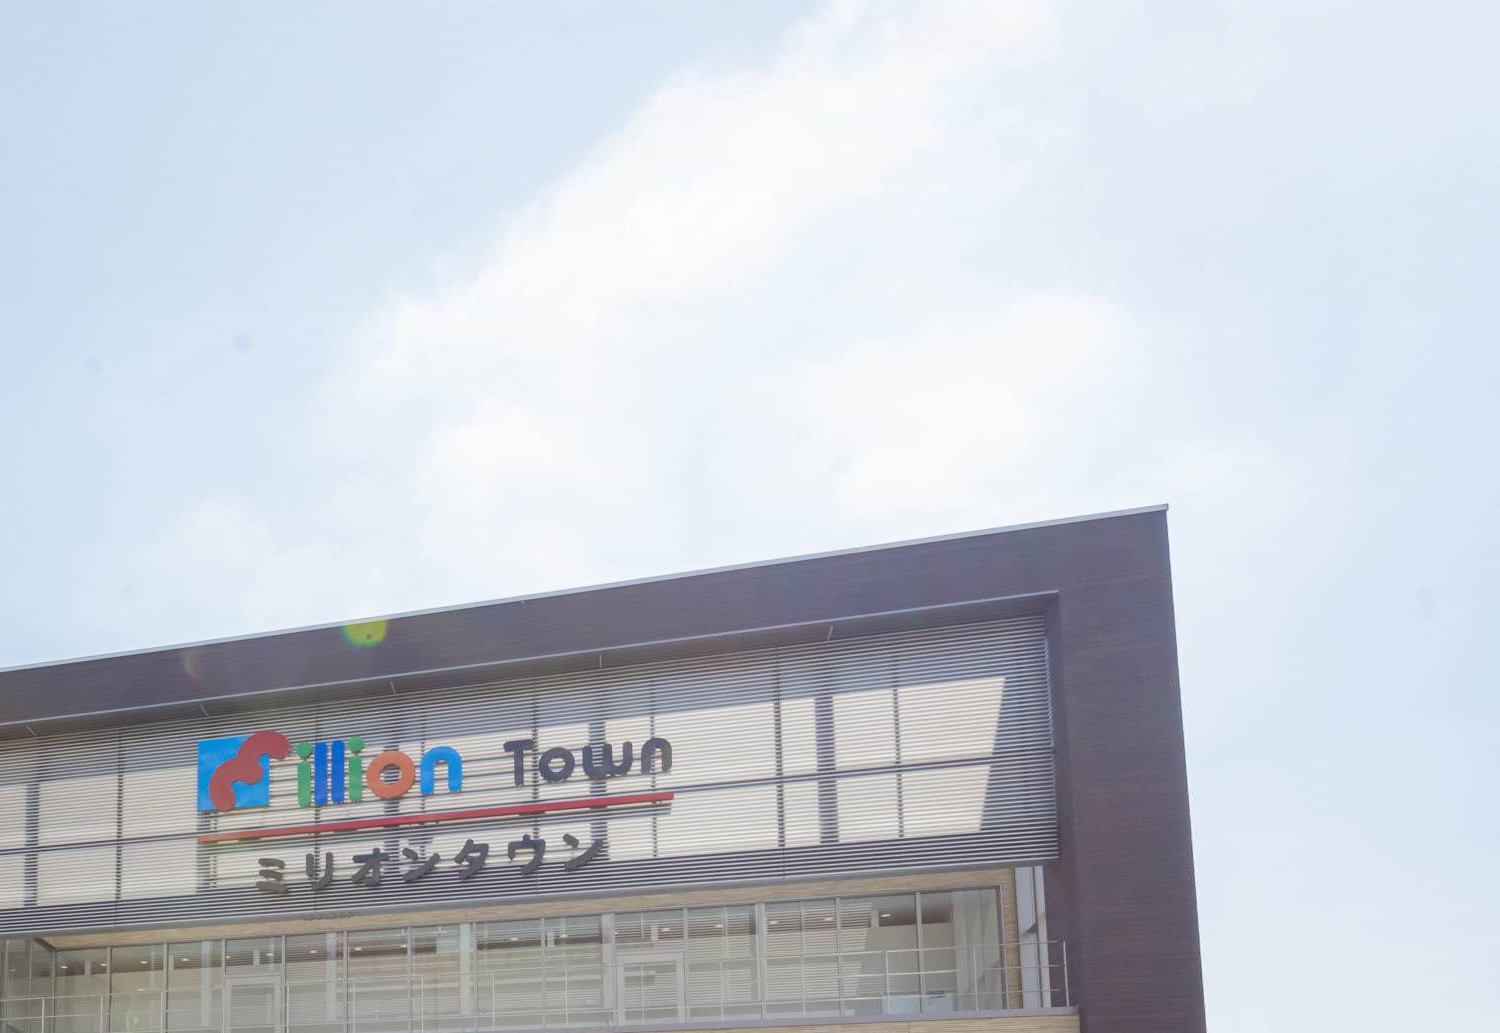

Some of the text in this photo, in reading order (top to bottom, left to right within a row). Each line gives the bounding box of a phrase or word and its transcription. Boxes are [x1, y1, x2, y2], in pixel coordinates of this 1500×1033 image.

[256, 833, 605, 893] ミリオンタウン
